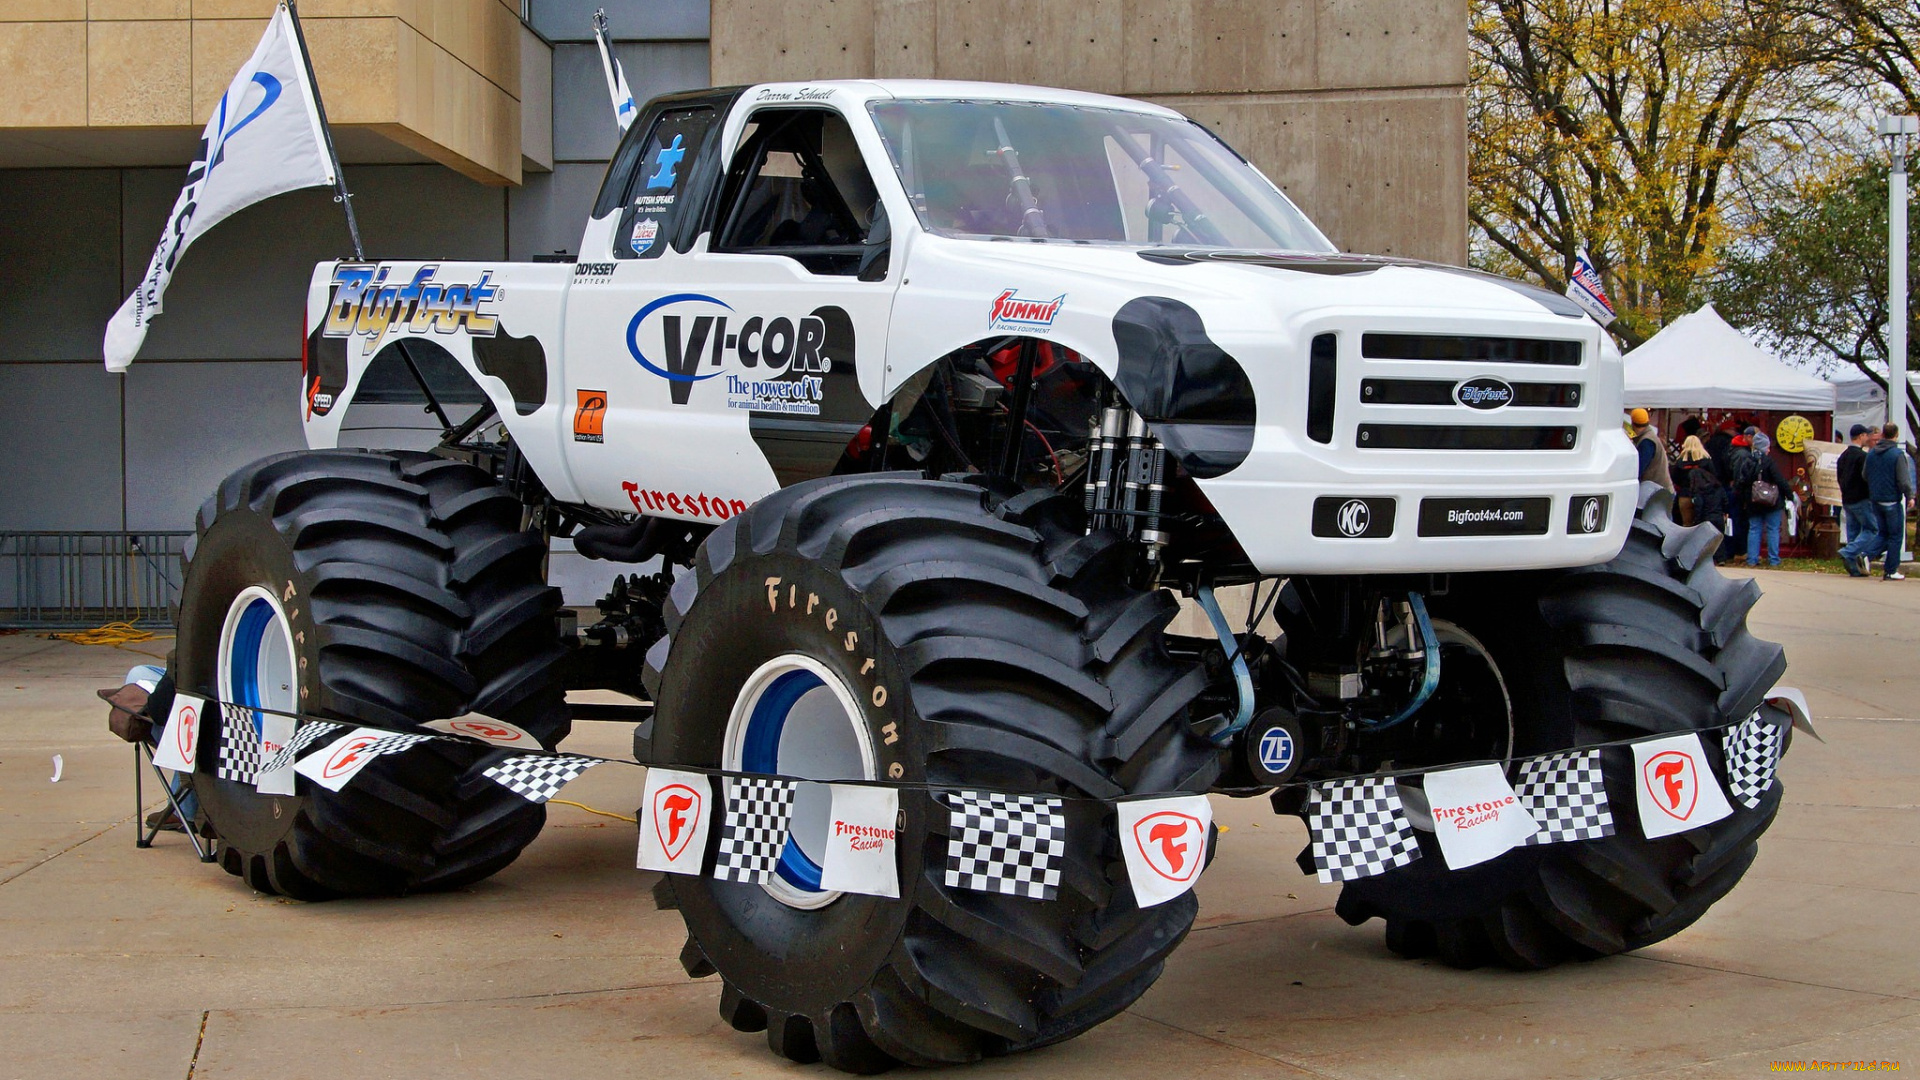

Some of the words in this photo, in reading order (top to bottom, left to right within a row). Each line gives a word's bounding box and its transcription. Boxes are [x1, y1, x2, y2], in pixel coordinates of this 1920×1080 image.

[794, 87, 837, 100] Schnell
[634, 196, 655, 205] AUTISM
[655, 195, 675, 204] SPEAKS
[574, 263, 618, 275] ODYSSEY
[323, 264, 500, 357] Bigfoot
[990, 290, 1060, 323] SUMMIT
[996, 324, 1017, 332] RACING
[1017, 326, 1051, 334] EQUIPMENT
[726, 374, 750, 394] The
[752, 380, 791, 400] power
[793, 376, 809, 398] of
[1461, 386, 1509, 404] Bigfoot
[728, 398, 738, 409] for
[739, 399, 760, 410] animal
[761, 400, 782, 412] health
[789, 401, 819, 414] nutrition
[622, 480, 752, 520] Fireston
[1341, 502, 1366, 534] KC
[1447, 509, 1525, 525] Bigfoot4x4.com
[1583, 500, 1598, 533] KC
[764, 576, 905, 780] Firestone
[1262, 736, 1291, 764] ZF
[1655, 757, 1684, 811] F
[663, 794, 693, 847] F
[1432, 796, 1515, 823] Firestone
[1454, 809, 1500, 832] Racing
[835, 820, 896, 840] Firestone
[849, 836, 884, 854] Racing
[1149, 820, 1188, 874] F
